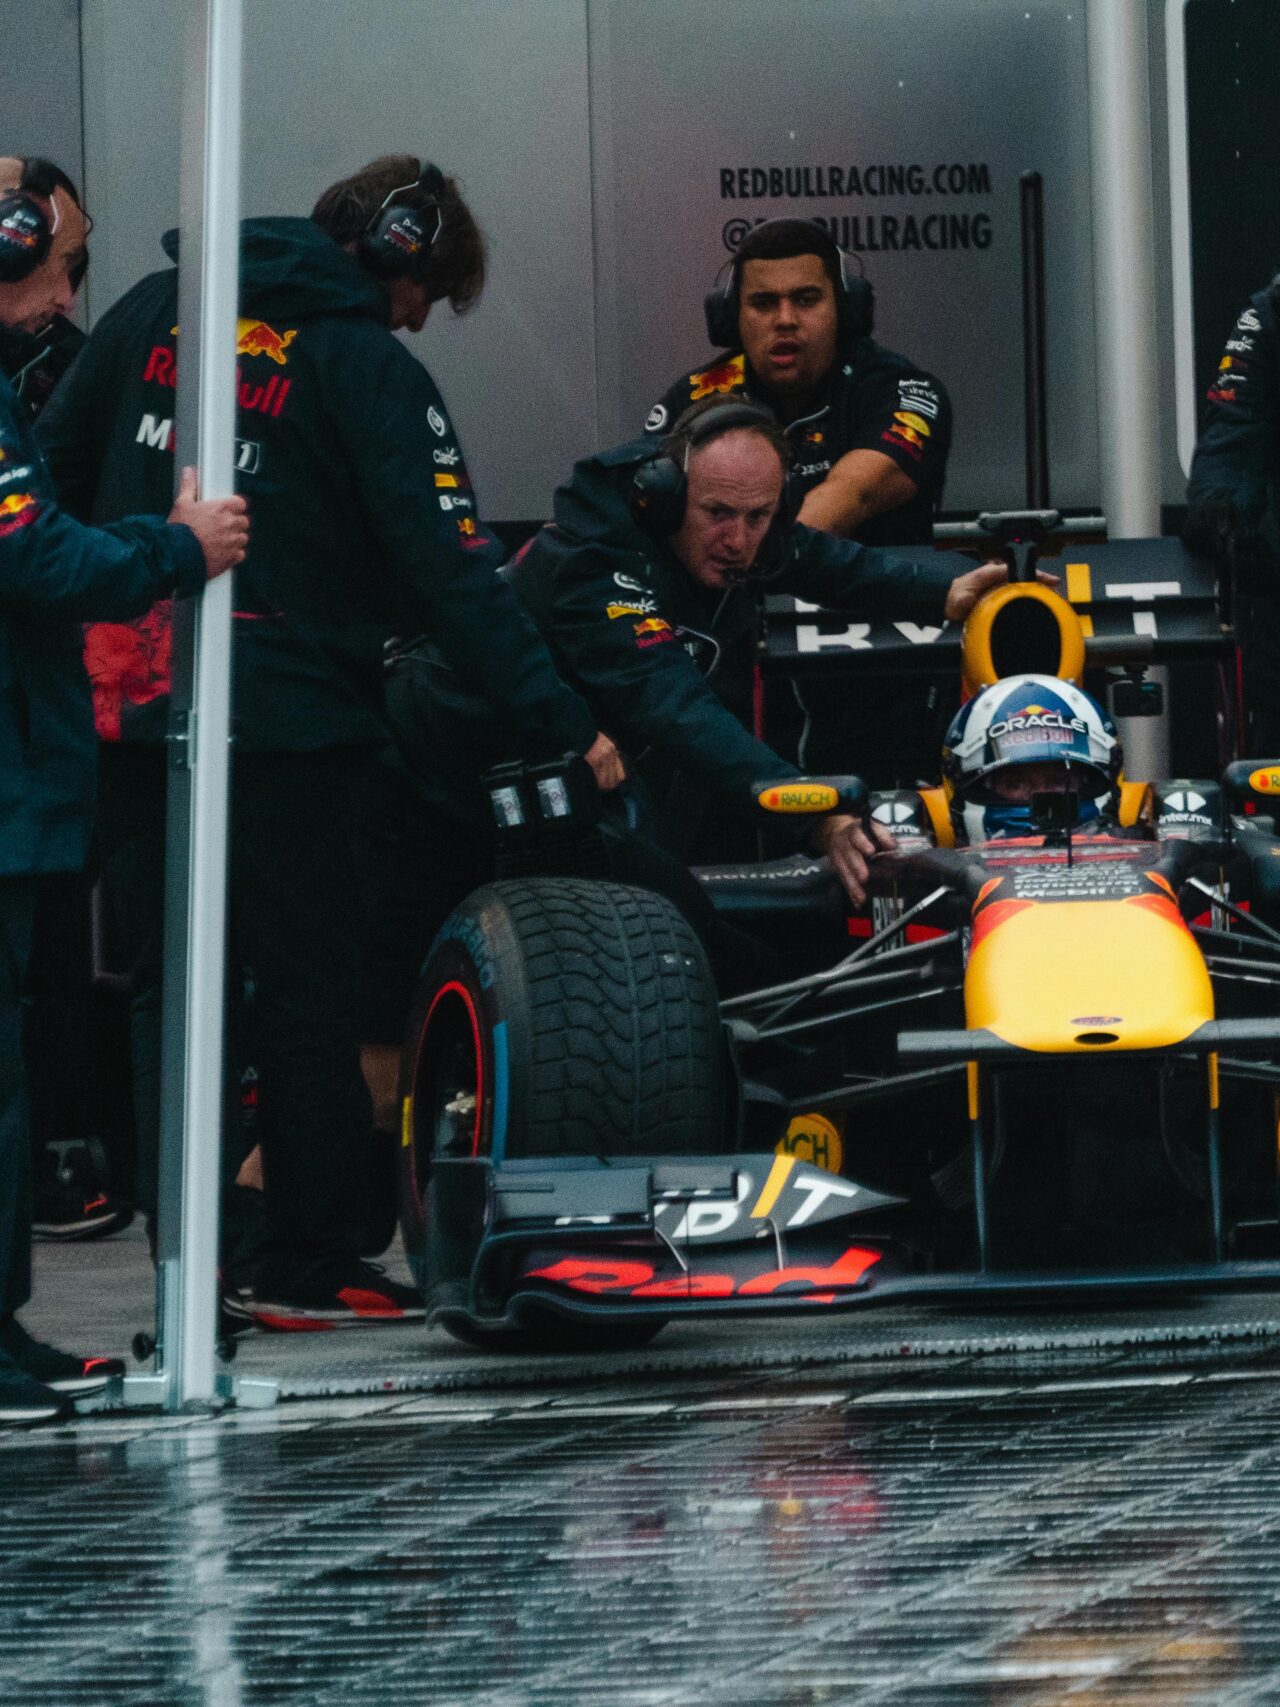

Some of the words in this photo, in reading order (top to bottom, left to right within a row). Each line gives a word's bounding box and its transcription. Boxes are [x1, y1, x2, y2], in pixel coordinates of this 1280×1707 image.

[720, 163, 991, 198] REDBULLRACING.COM
[236, 365, 292, 417] ull
[988, 714, 1087, 738] ORACLE
[781, 792, 829, 806] RAUCH
